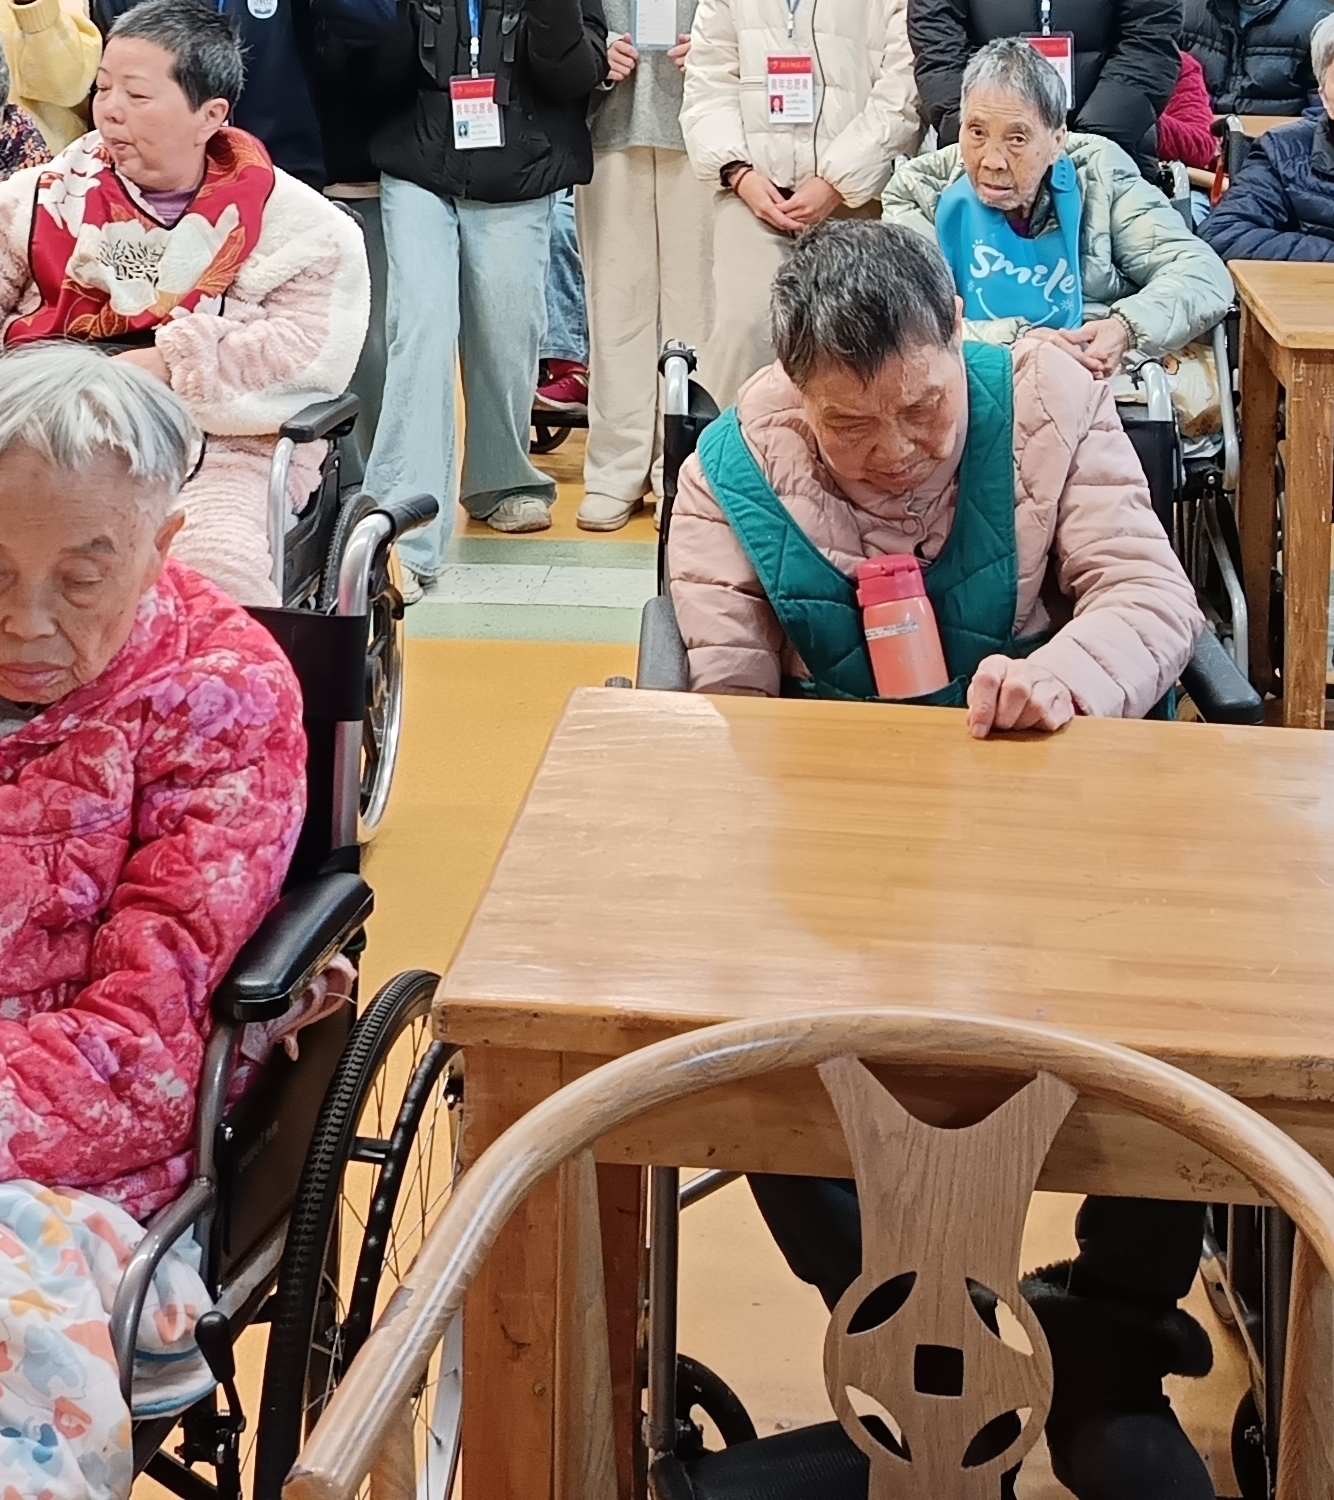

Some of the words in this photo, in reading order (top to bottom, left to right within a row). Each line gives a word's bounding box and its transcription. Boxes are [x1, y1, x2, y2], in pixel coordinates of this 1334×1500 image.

[771, 78, 809, 90] 青年志愿者
